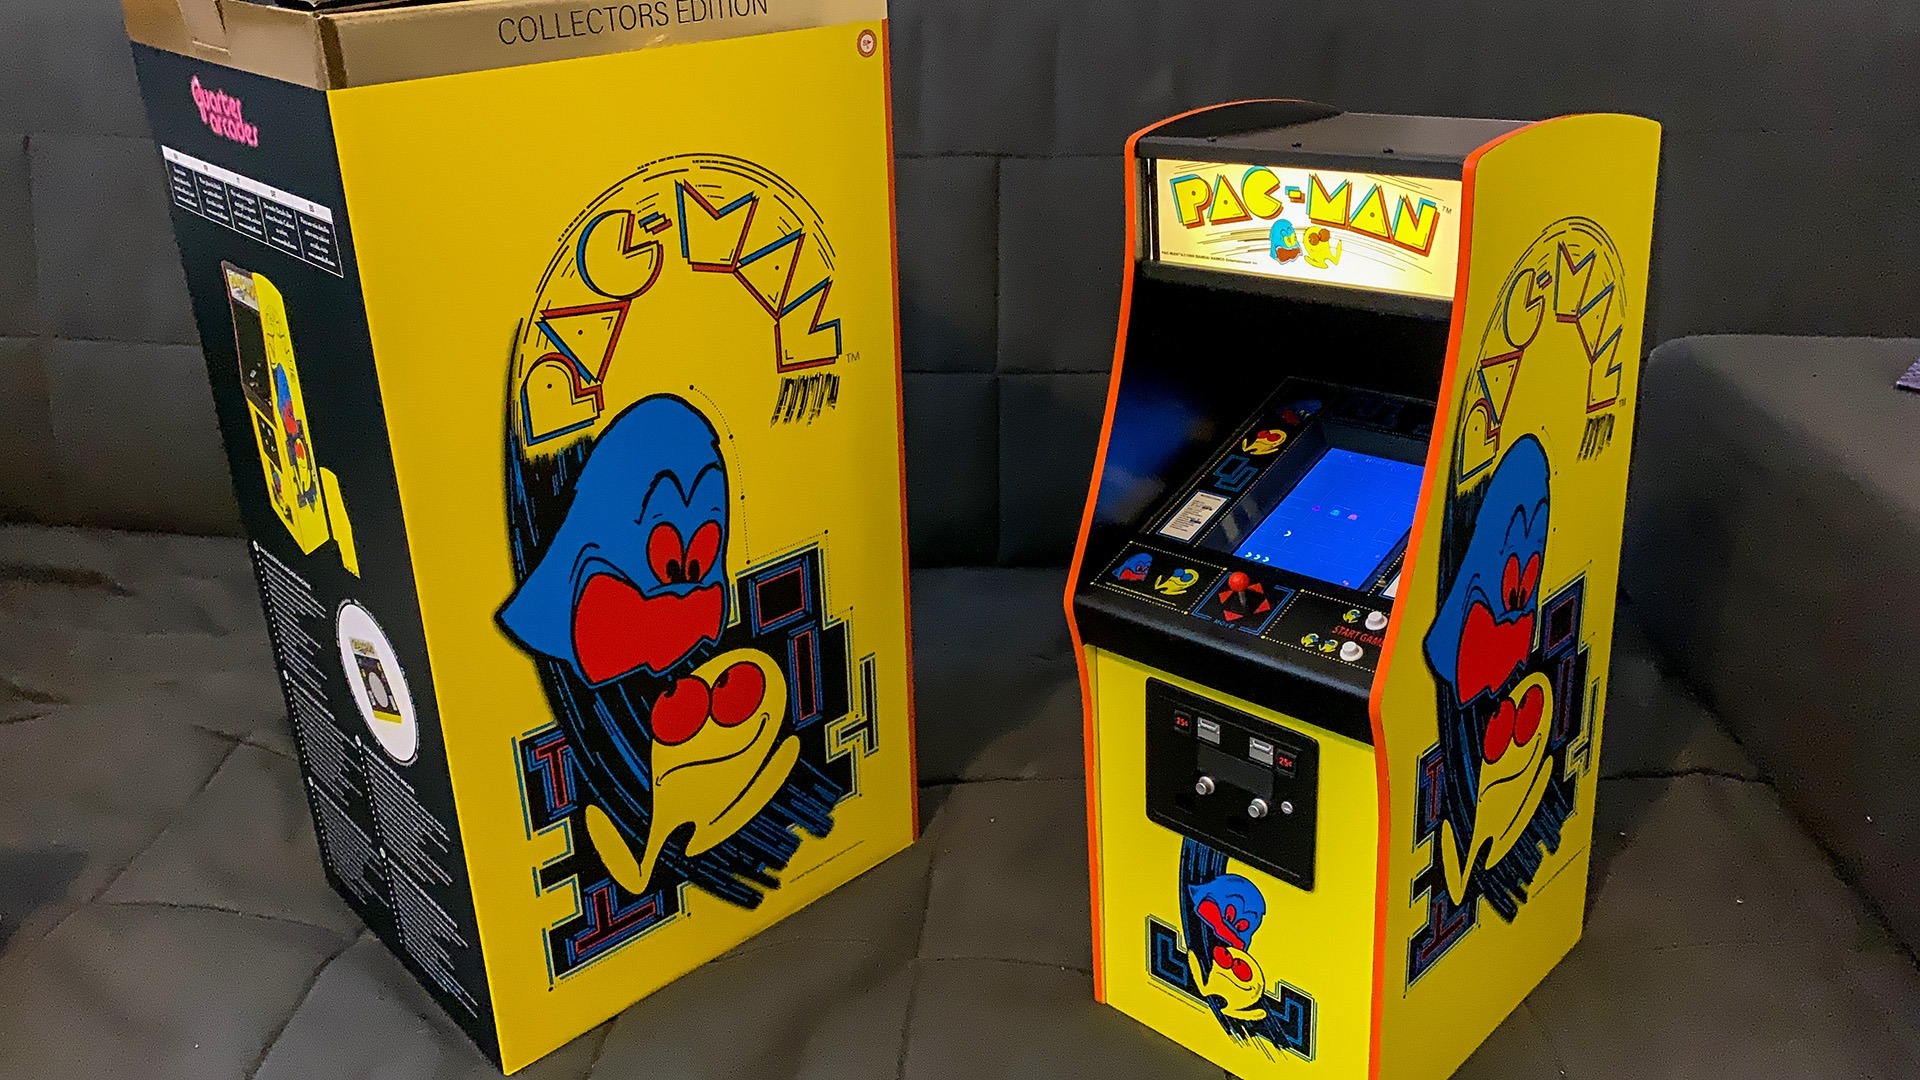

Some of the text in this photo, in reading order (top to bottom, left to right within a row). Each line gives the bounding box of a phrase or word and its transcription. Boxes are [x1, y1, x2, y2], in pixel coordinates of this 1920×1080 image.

[498, 0, 768, 45] COLLECTORS EDITION
[1169, 165, 1441, 257] PAC-MAN
[520, 178, 842, 447] PAC-MAN
[1457, 241, 1623, 485] PAC-MAN
[1331, 625, 1360, 639] START
